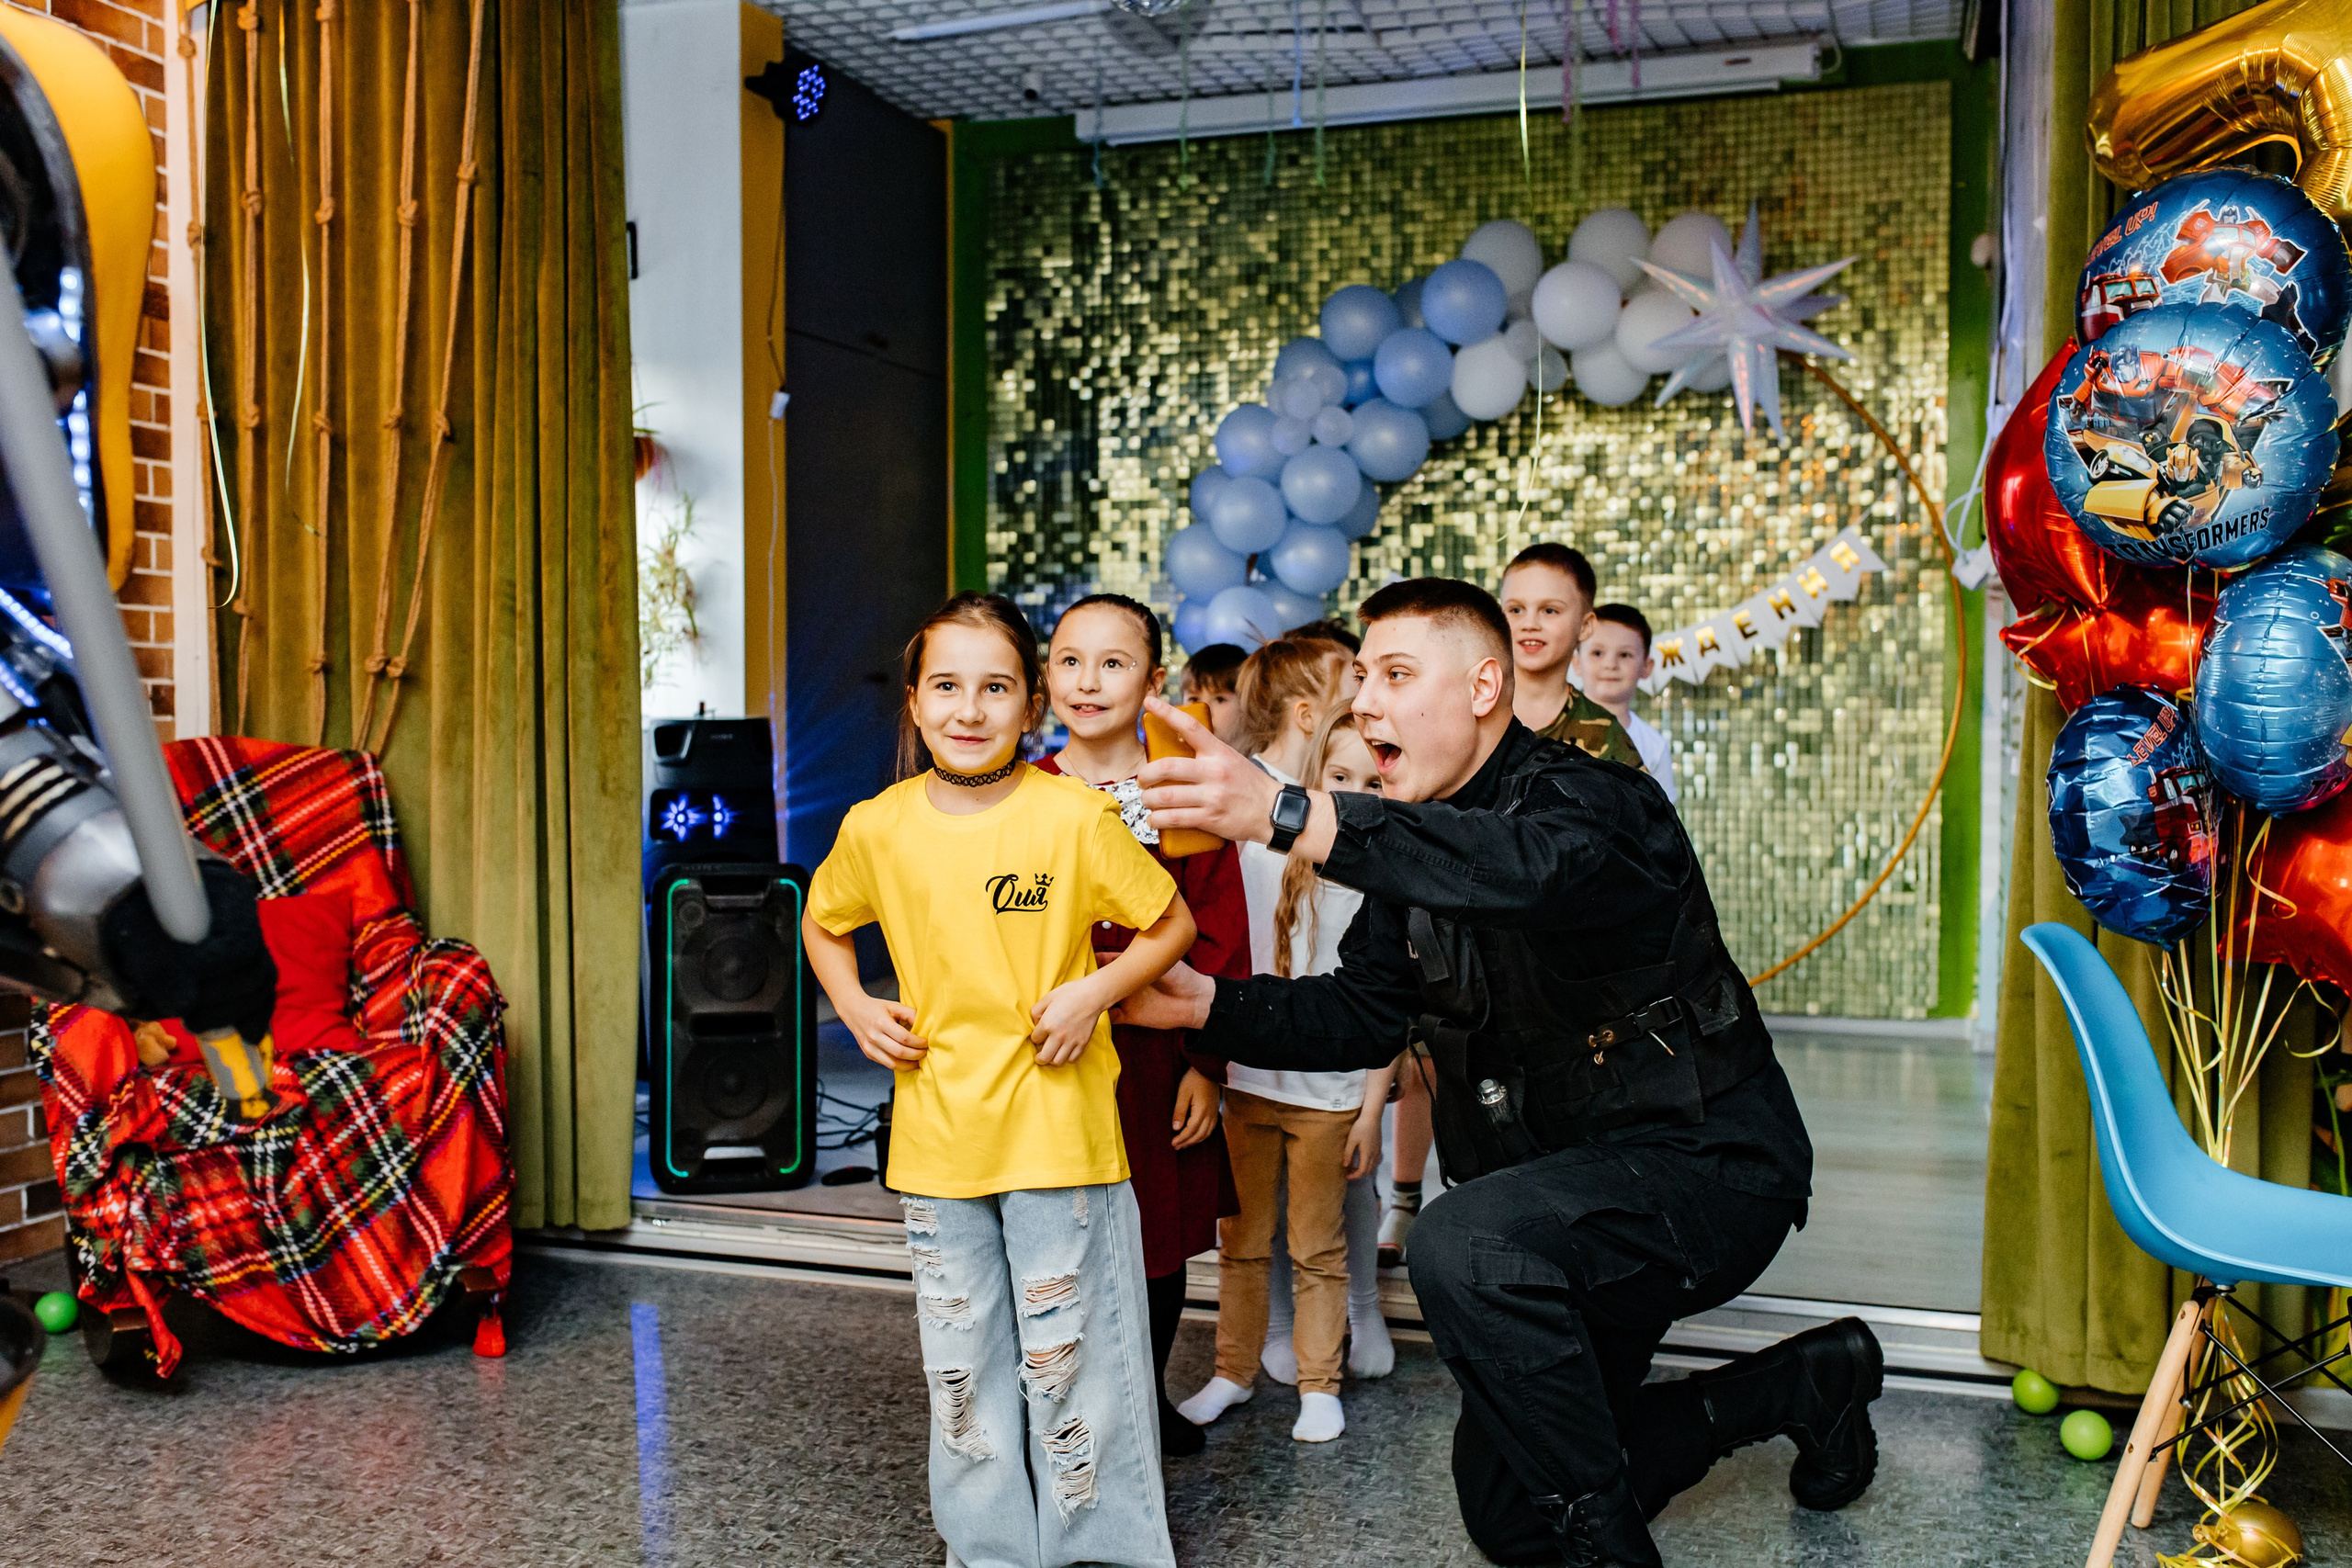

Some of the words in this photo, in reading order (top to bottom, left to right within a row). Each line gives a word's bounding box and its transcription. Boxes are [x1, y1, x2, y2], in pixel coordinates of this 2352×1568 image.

[2124, 201, 2159, 236] UP!
[2103, 506, 2271, 561] TRANSFORMERS
[1656, 540, 1860, 669] ЖДЕНИЯ
[2126, 721, 2168, 767] LEVEL
